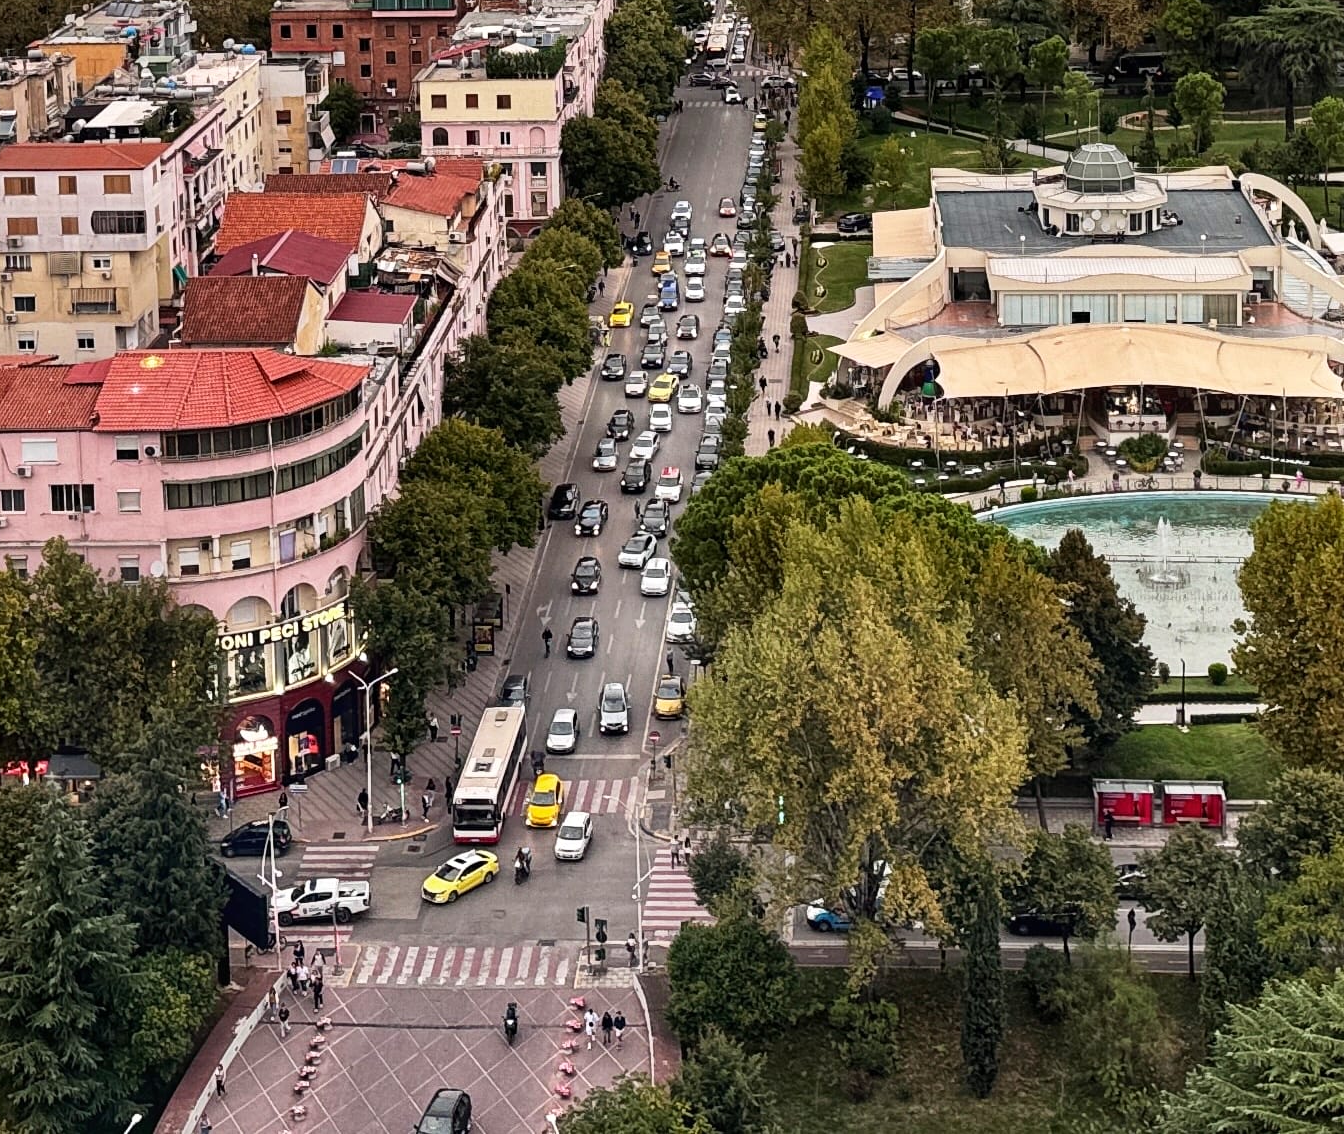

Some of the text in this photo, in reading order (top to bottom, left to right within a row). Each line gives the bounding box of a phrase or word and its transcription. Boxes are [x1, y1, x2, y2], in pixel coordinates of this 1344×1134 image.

[215, 602, 345, 651] ONI PECI STORE
